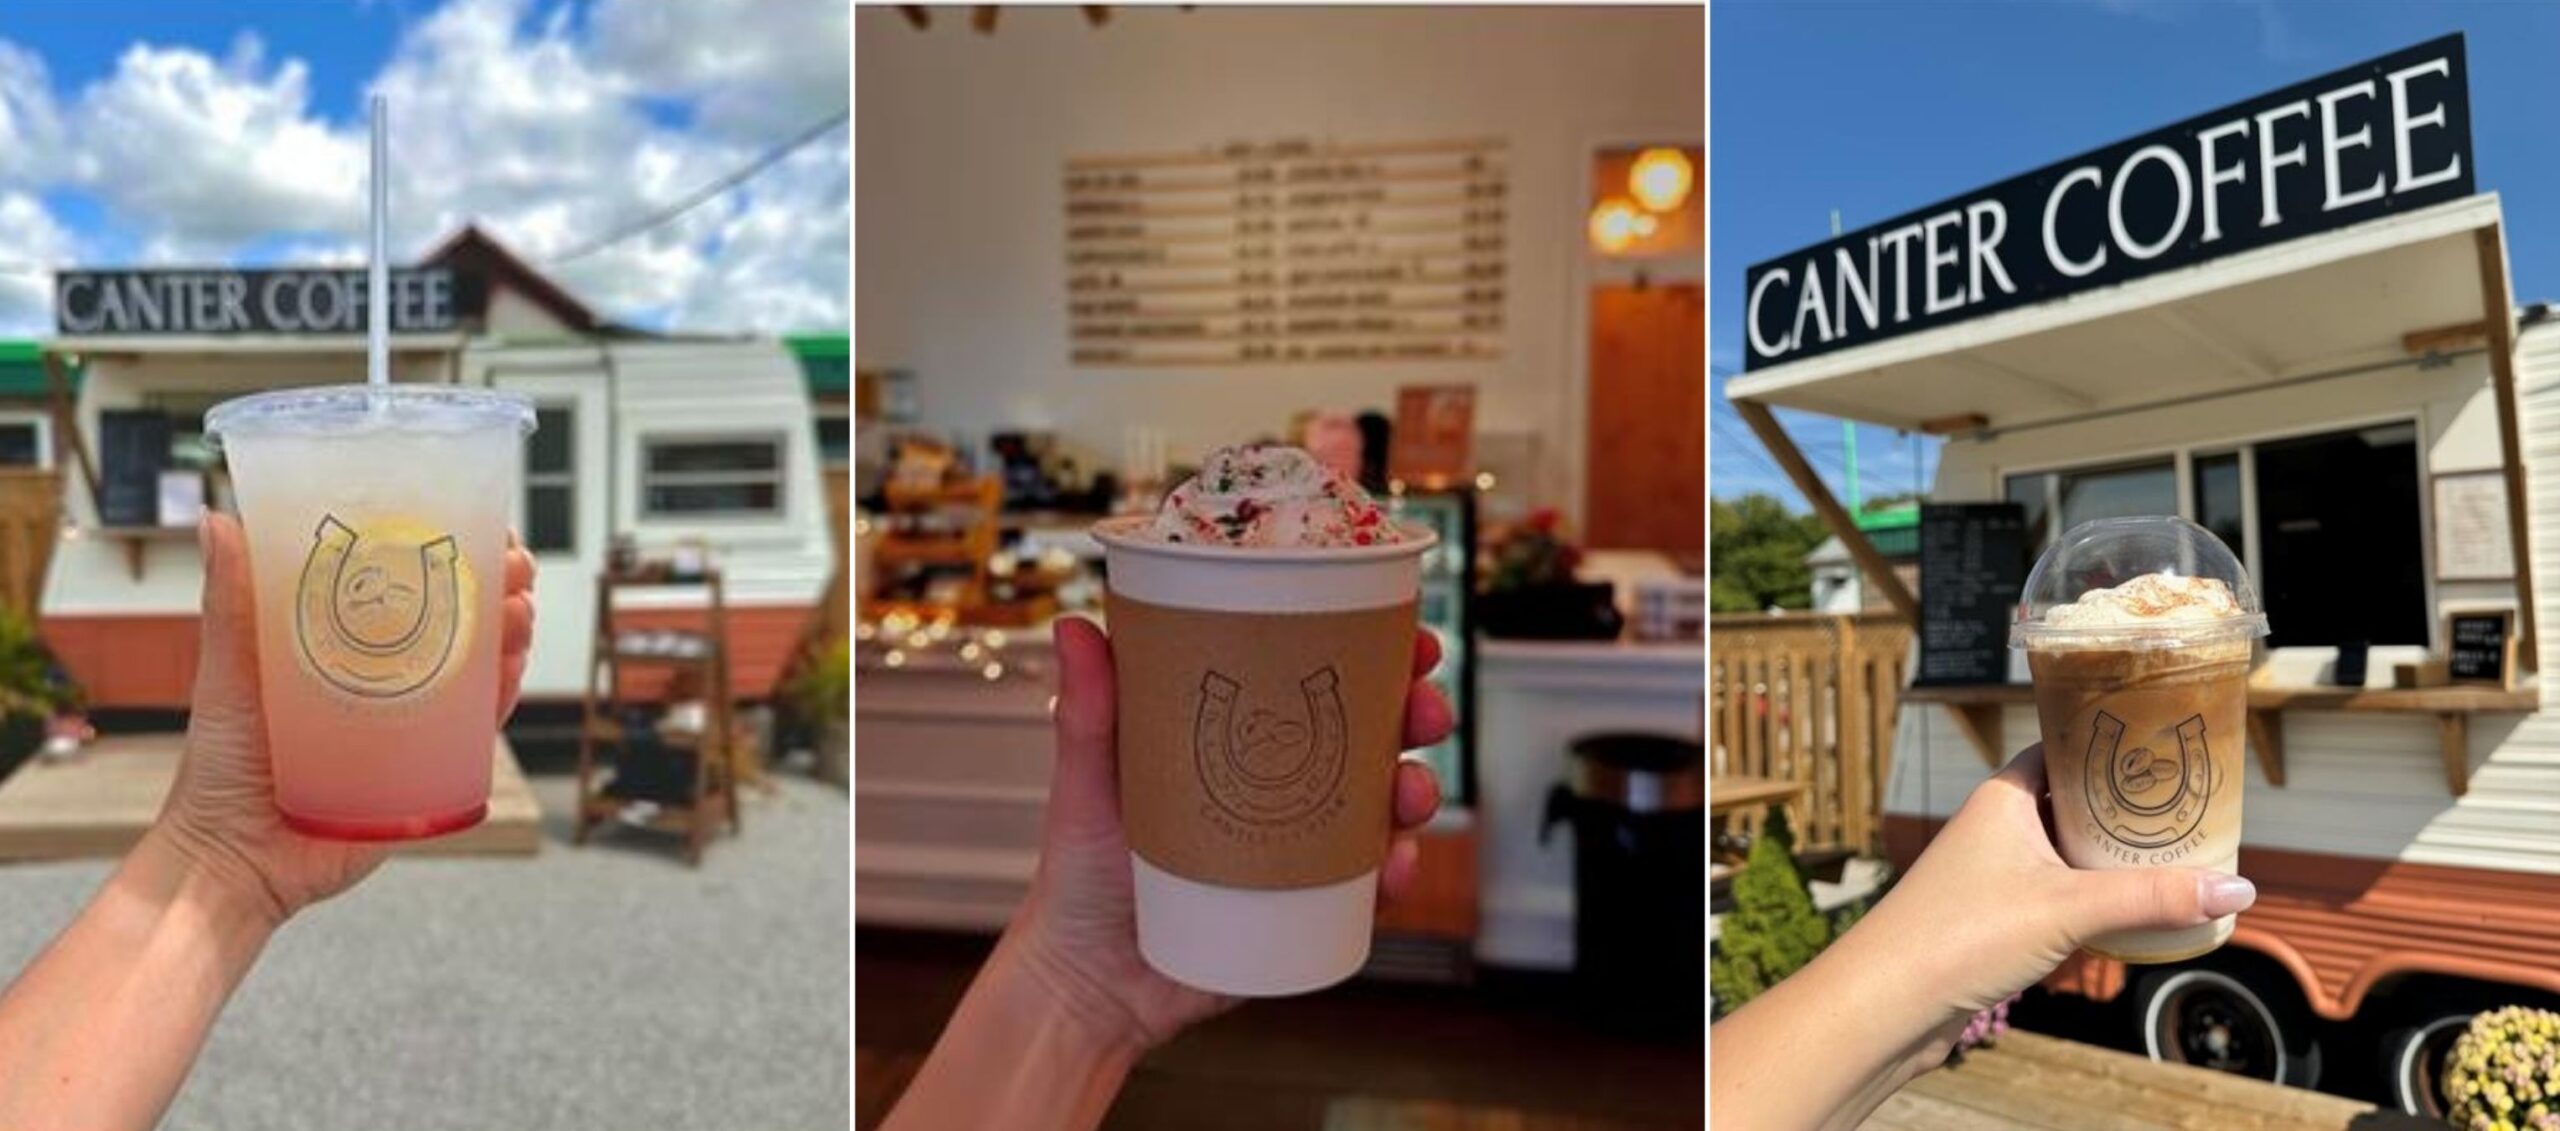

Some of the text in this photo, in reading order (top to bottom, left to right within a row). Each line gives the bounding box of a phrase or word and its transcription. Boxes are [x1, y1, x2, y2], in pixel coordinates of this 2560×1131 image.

[1747, 58, 2461, 358] CANTER COFFEE
[61, 273, 453, 332] CANTER COFEE
[2086, 822, 2209, 865] CANTER COFFEE
